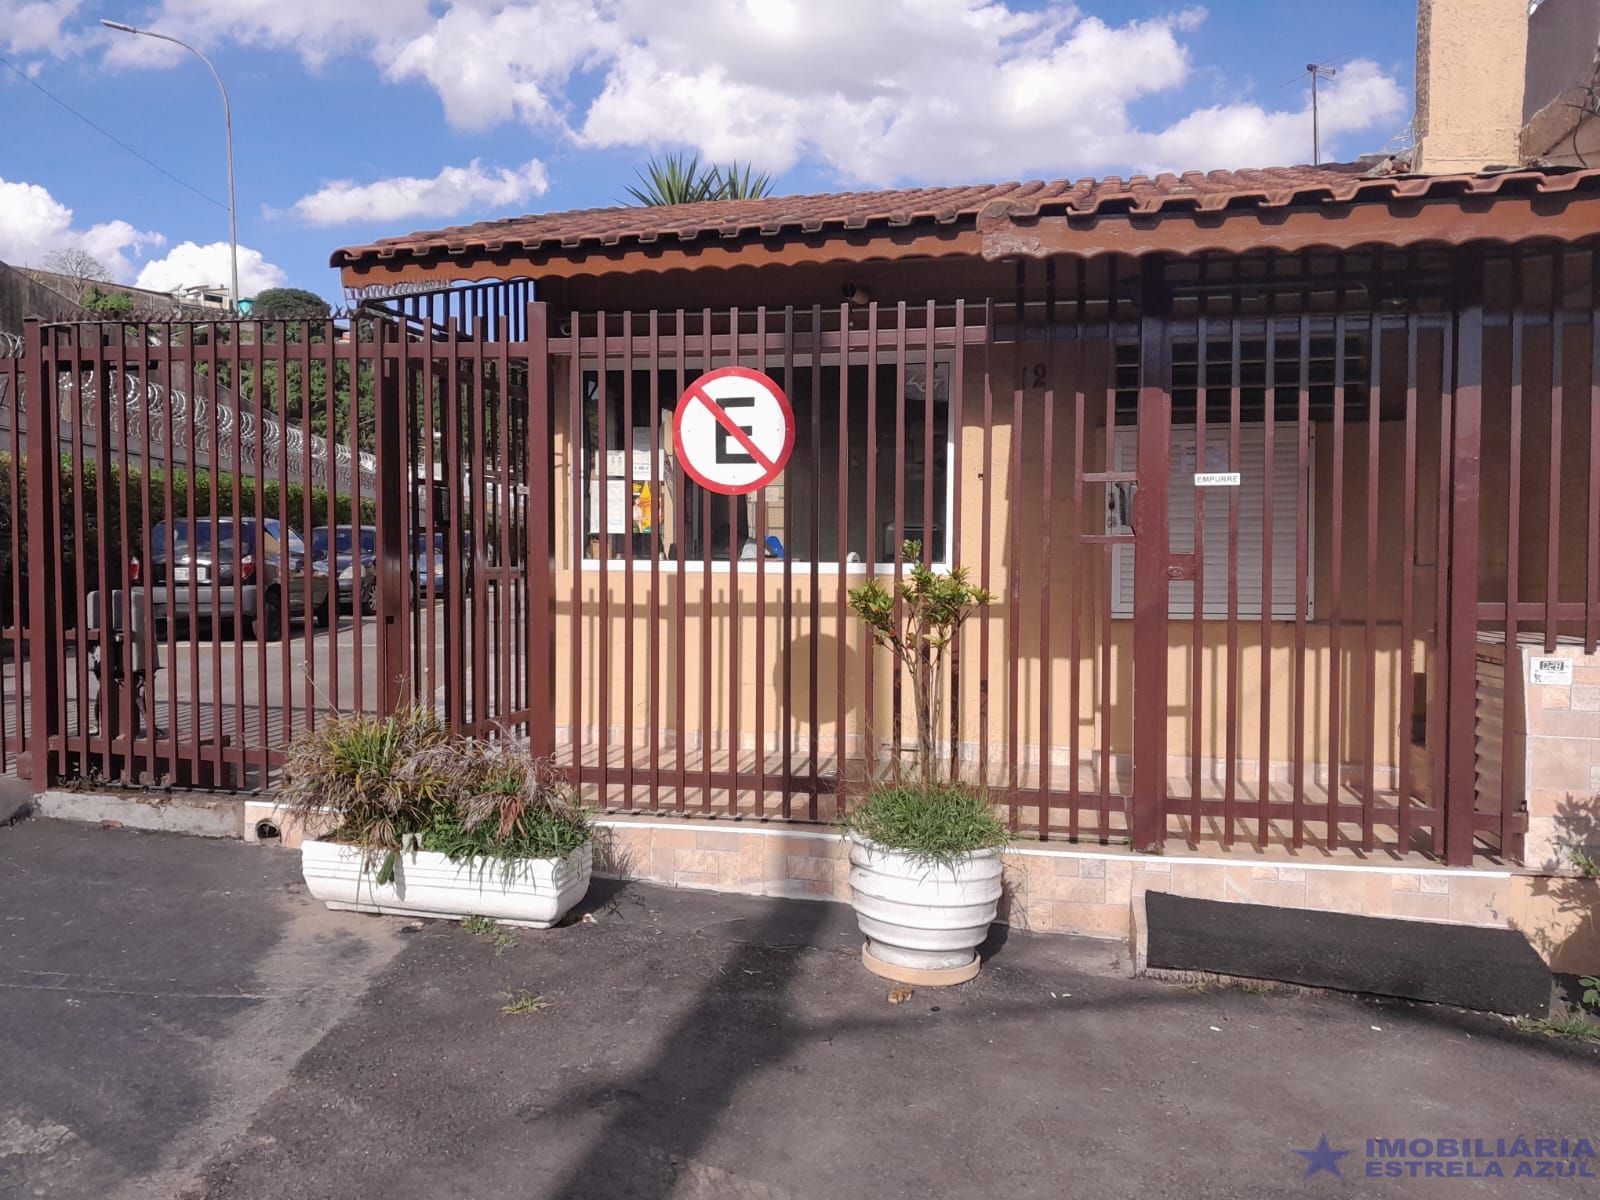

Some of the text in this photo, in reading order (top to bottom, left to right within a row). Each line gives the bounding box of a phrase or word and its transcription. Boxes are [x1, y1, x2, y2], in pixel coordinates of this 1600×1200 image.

[1022, 363, 1046, 389] 12
[715, 397, 758, 464] E
[1196, 475, 1239, 484] EMPURRE
